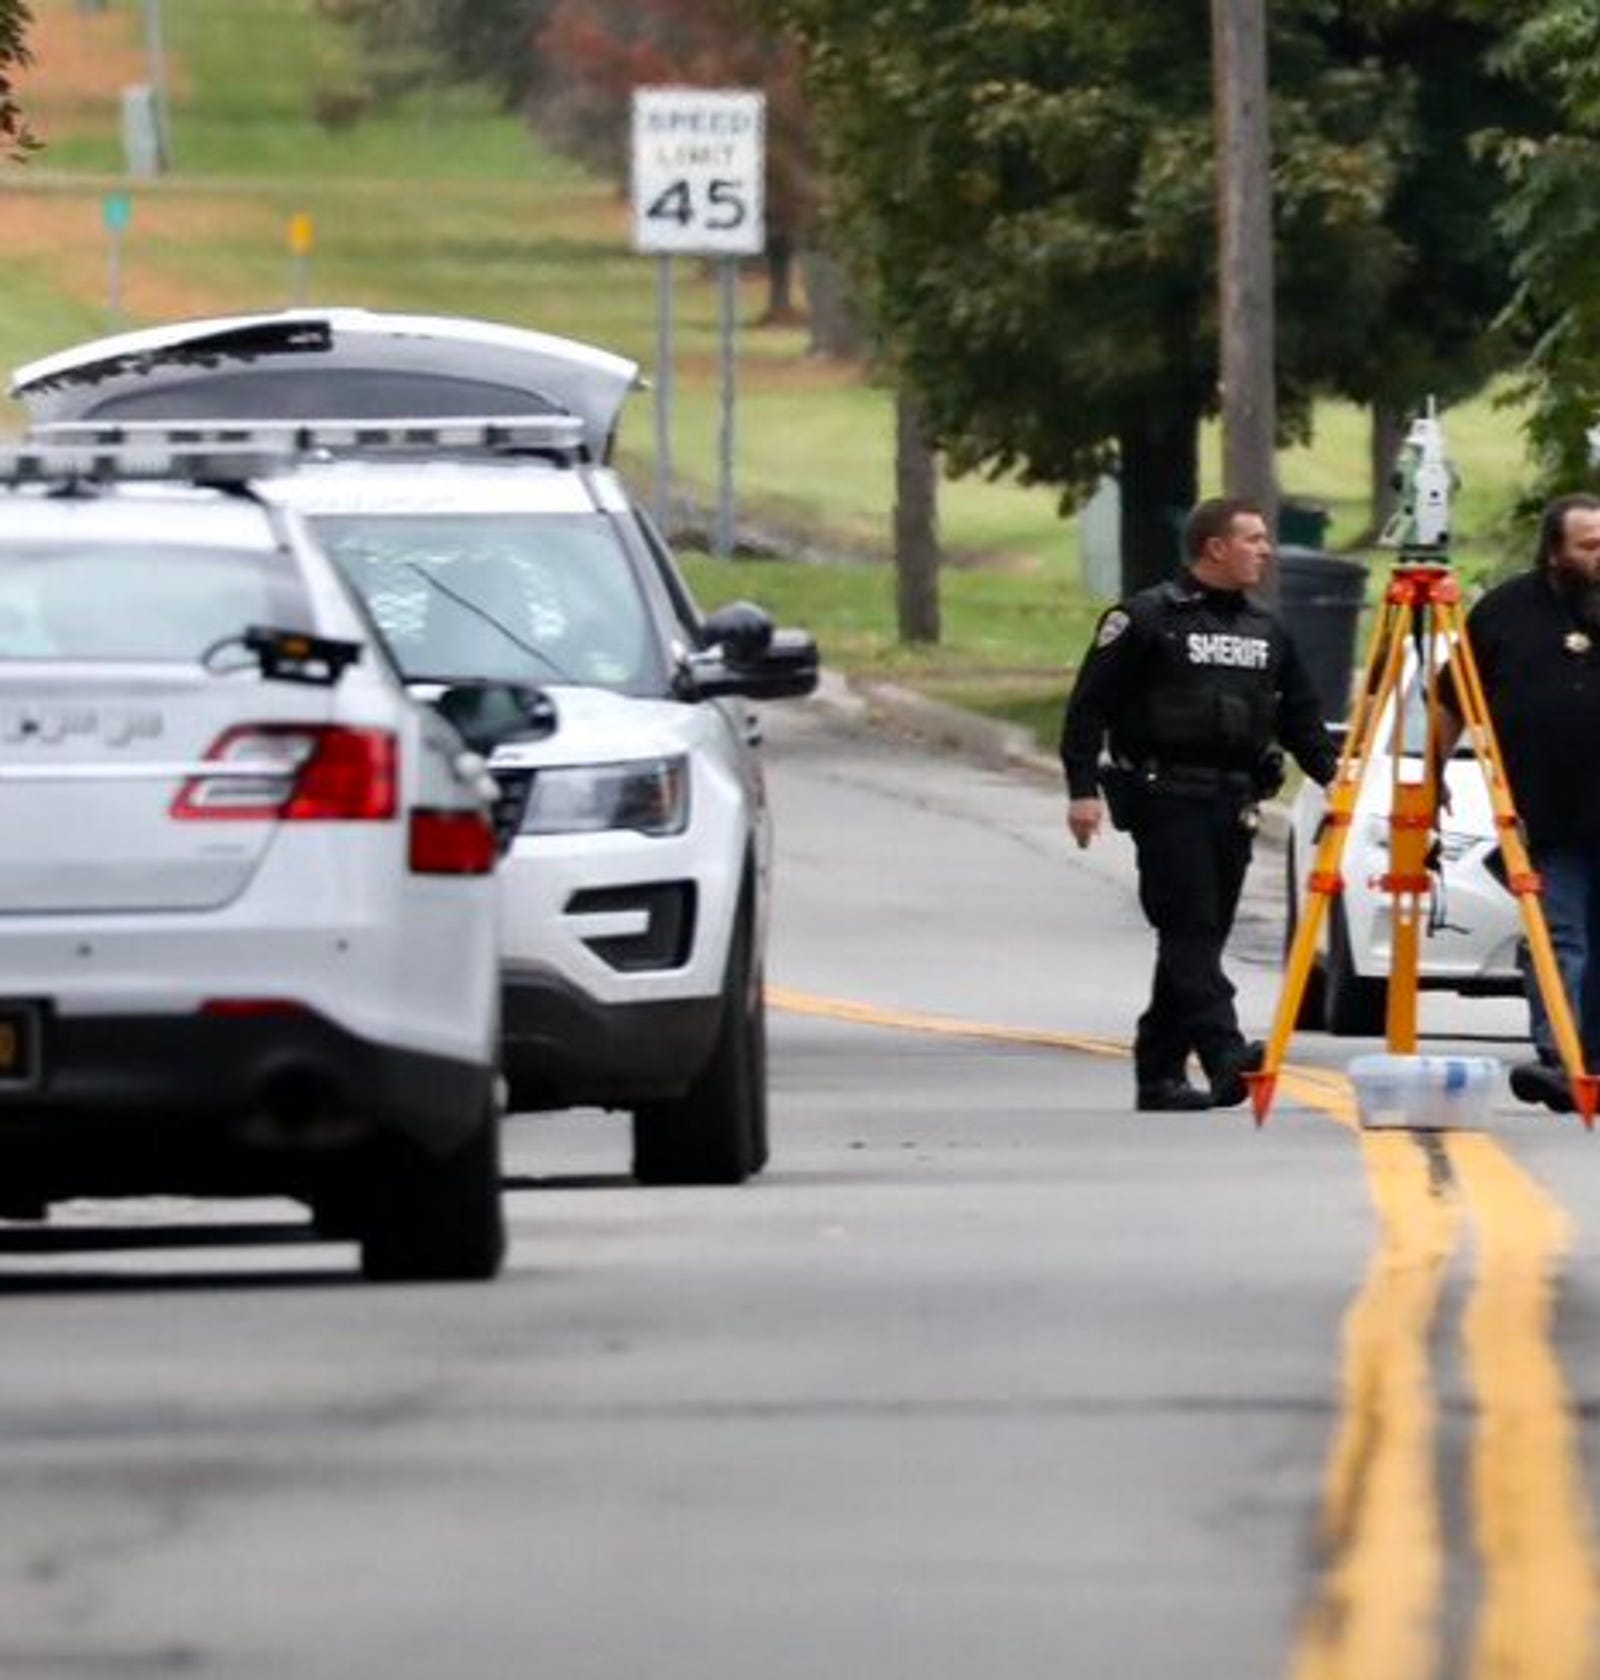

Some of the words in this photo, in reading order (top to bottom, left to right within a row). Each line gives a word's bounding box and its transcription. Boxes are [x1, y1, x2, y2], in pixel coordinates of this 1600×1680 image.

[648, 110, 752, 134] SPEED
[655, 144, 736, 166] LIMIT
[647, 179, 746, 230] 45
[1187, 633, 1269, 669] SHERIFF
